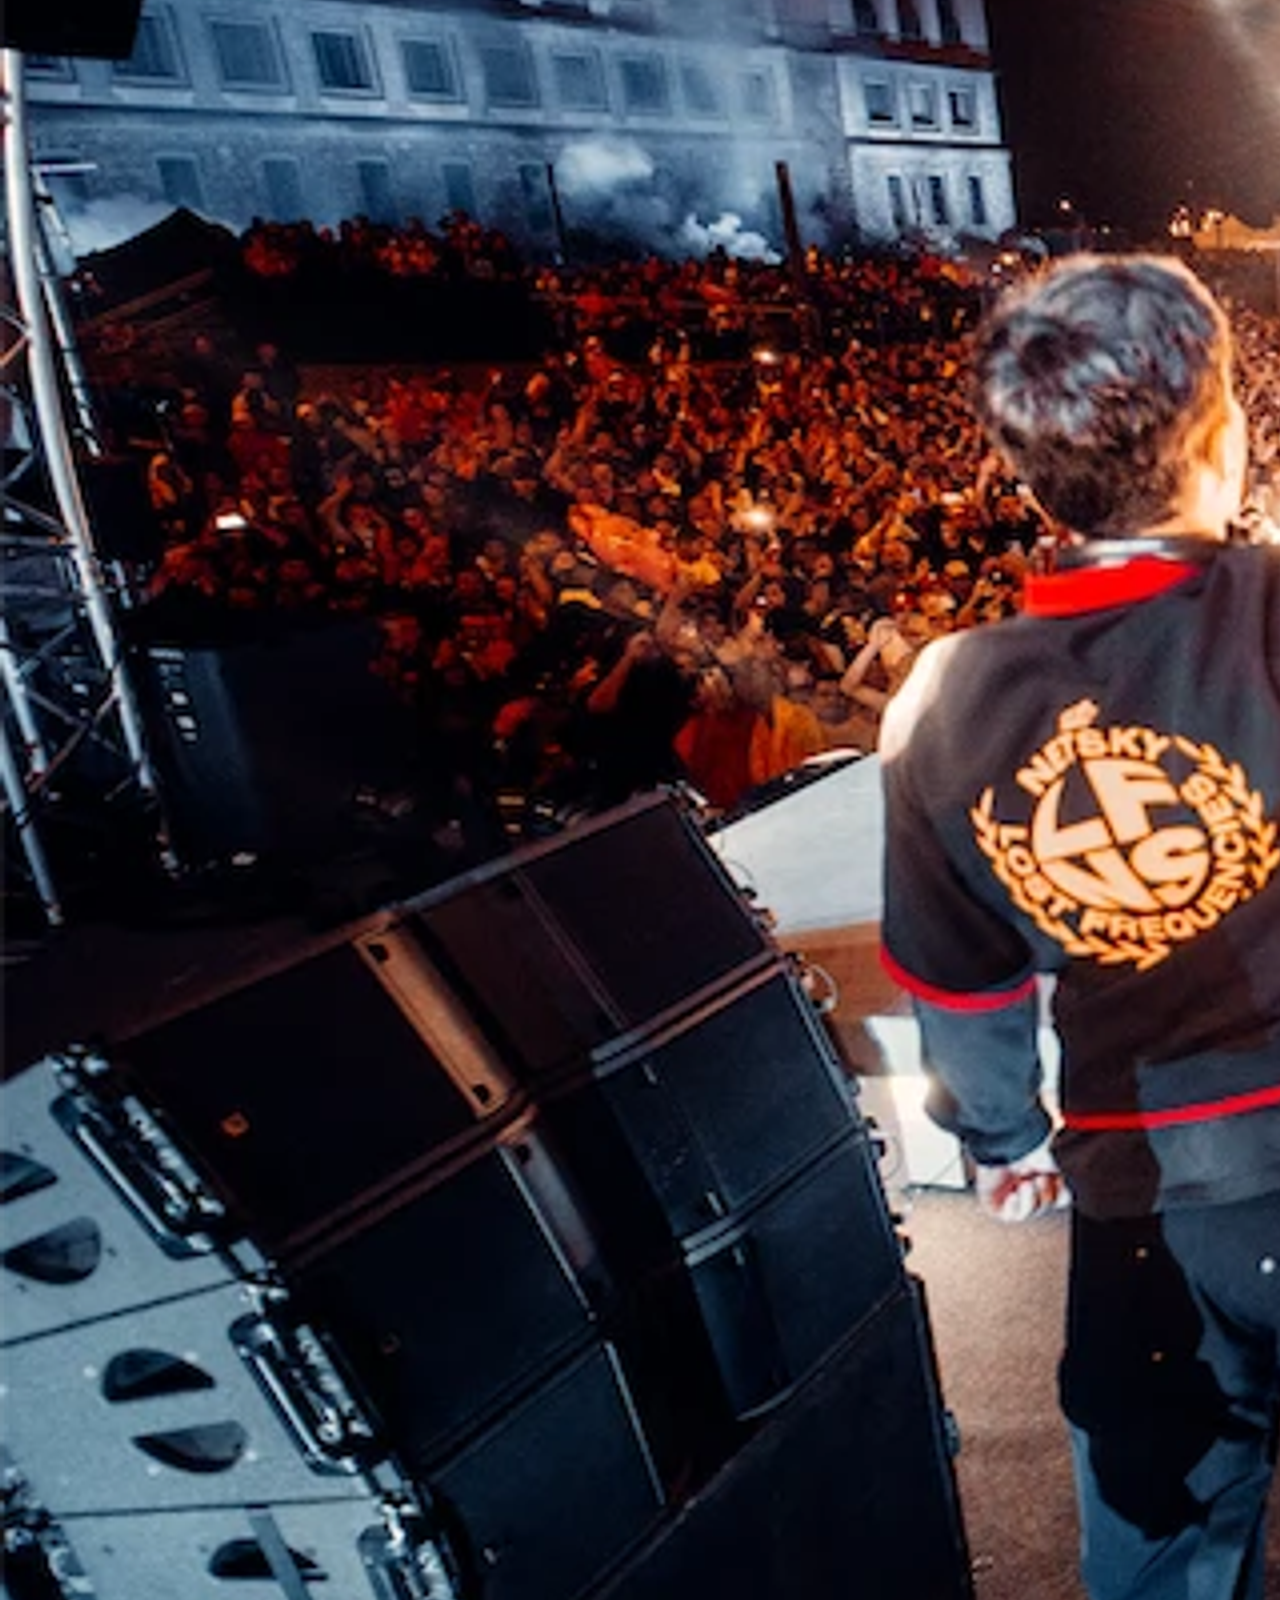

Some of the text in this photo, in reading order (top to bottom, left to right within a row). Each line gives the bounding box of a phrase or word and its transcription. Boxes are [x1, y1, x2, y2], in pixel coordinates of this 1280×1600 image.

[1016, 727, 1173, 797] NETSKY
[999, 772, 1249, 942] LOST FREQUENCIES
